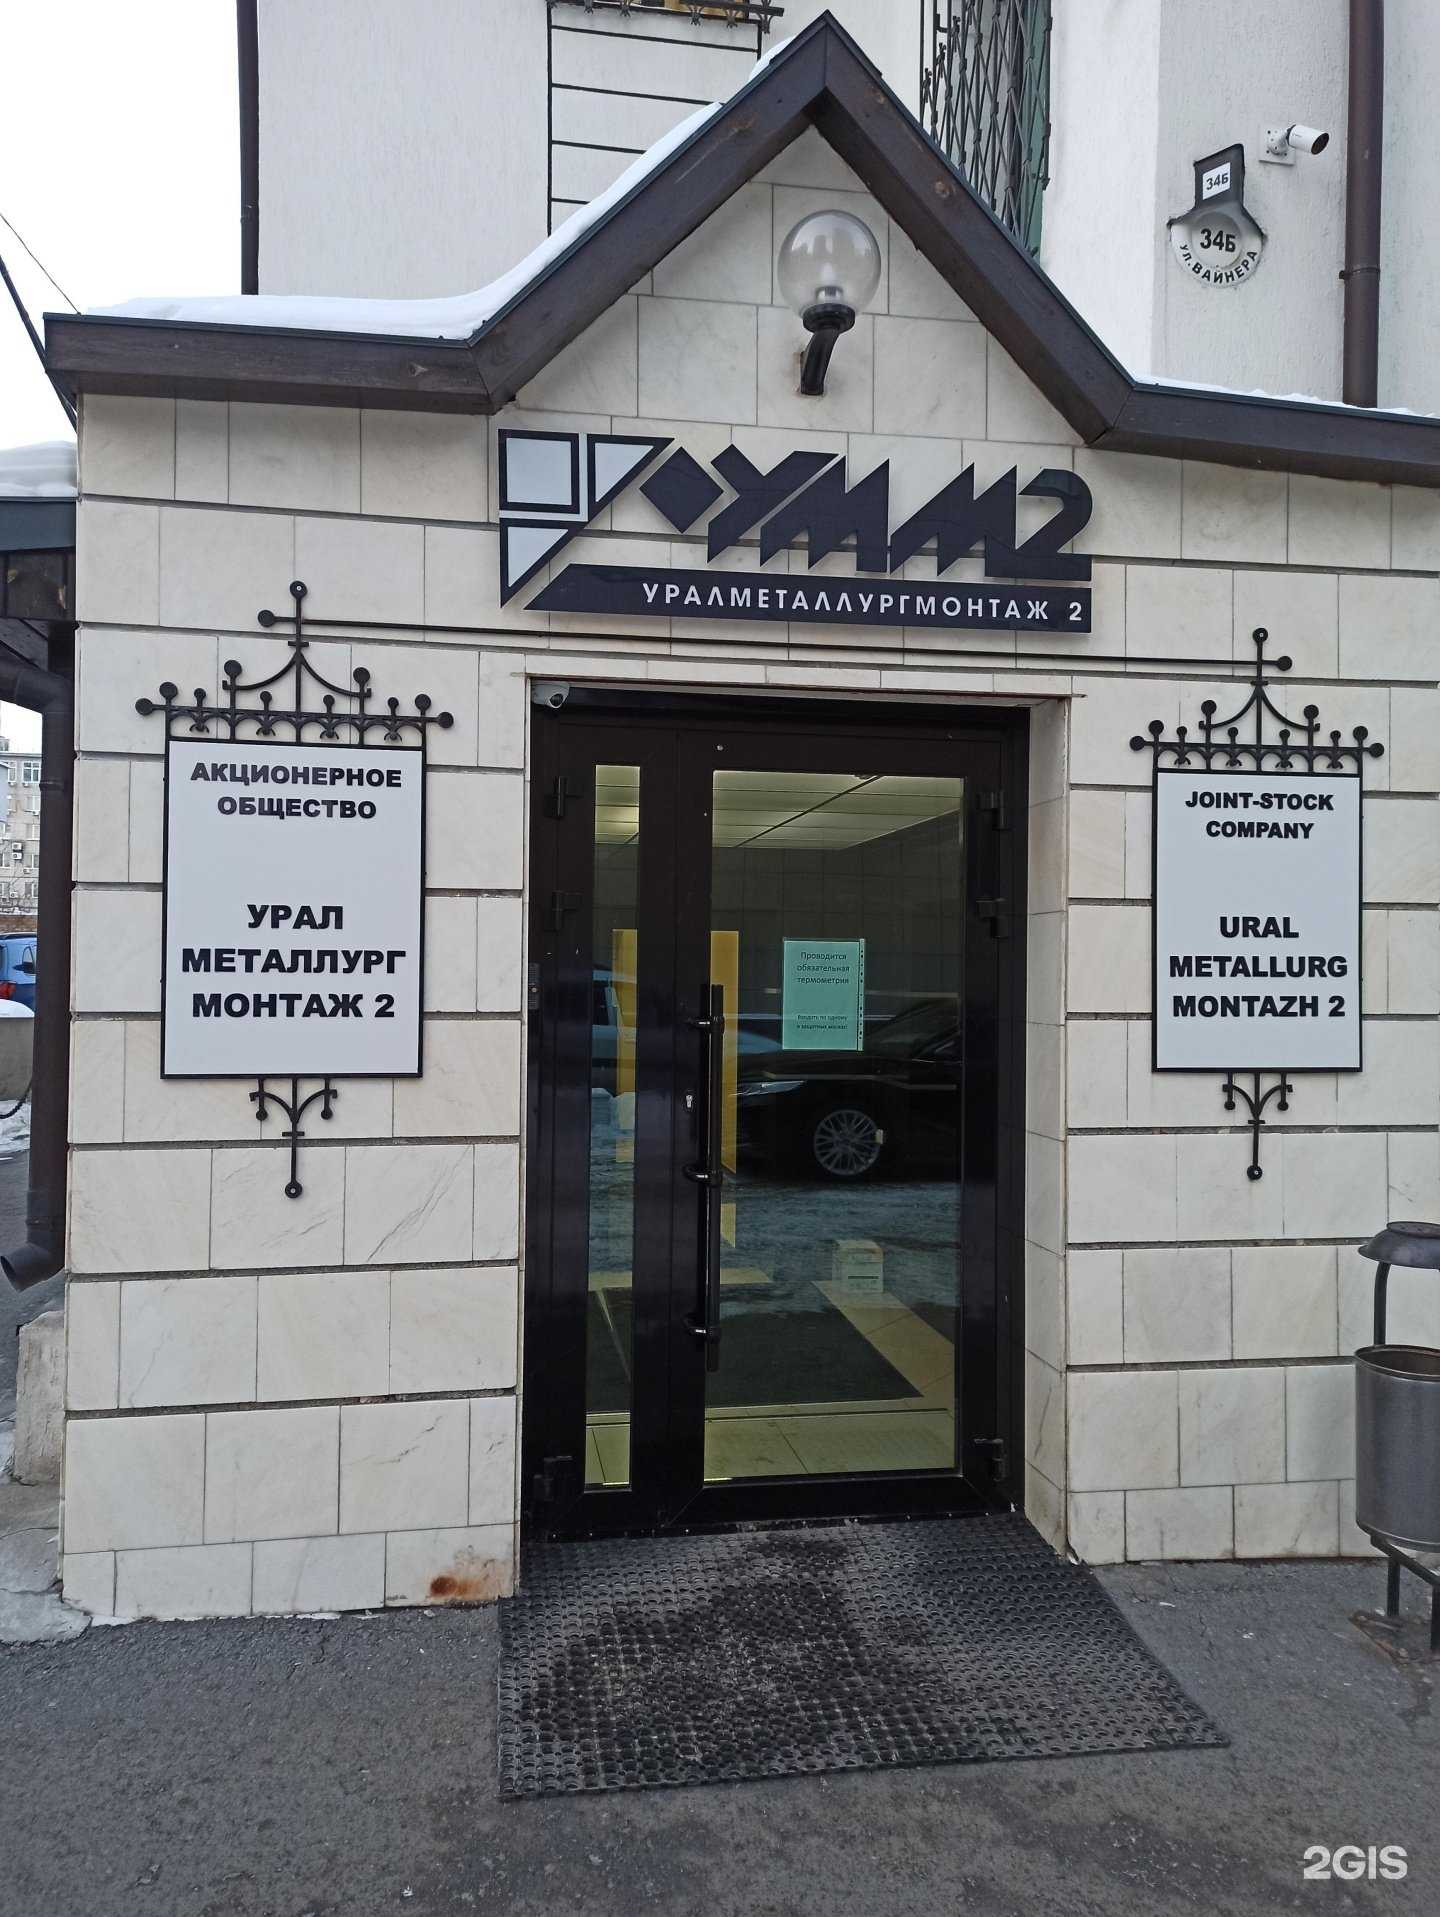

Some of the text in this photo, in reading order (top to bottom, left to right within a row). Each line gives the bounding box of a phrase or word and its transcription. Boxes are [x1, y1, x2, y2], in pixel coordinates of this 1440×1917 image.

[1206, 172, 1229, 190] 34Б
[1200, 228, 1236, 252] 34Б
[643, 583, 1083, 621] УРАЛМЕТАЛЛУРГМОНТАЖ 2
[190, 762, 402, 788] АКЦИОНЕРНОЕ
[217, 796, 377, 820] ОБЩЕСТВО
[1185, 791, 1334, 811] JOINT-STOCK
[1206, 820, 1315, 839] COMPANY
[246, 903, 344, 930] УРАЛ
[1219, 916, 1300, 939] URAL
[181, 948, 407, 974] МЕТАЛЛУРГ
[801, 951, 847, 960] Проводится
[1169, 955, 1348, 978] METALLURG
[192, 992, 395, 1018] МОНТАЖ 2
[1172, 995, 1346, 1018] MONTAZH 2
